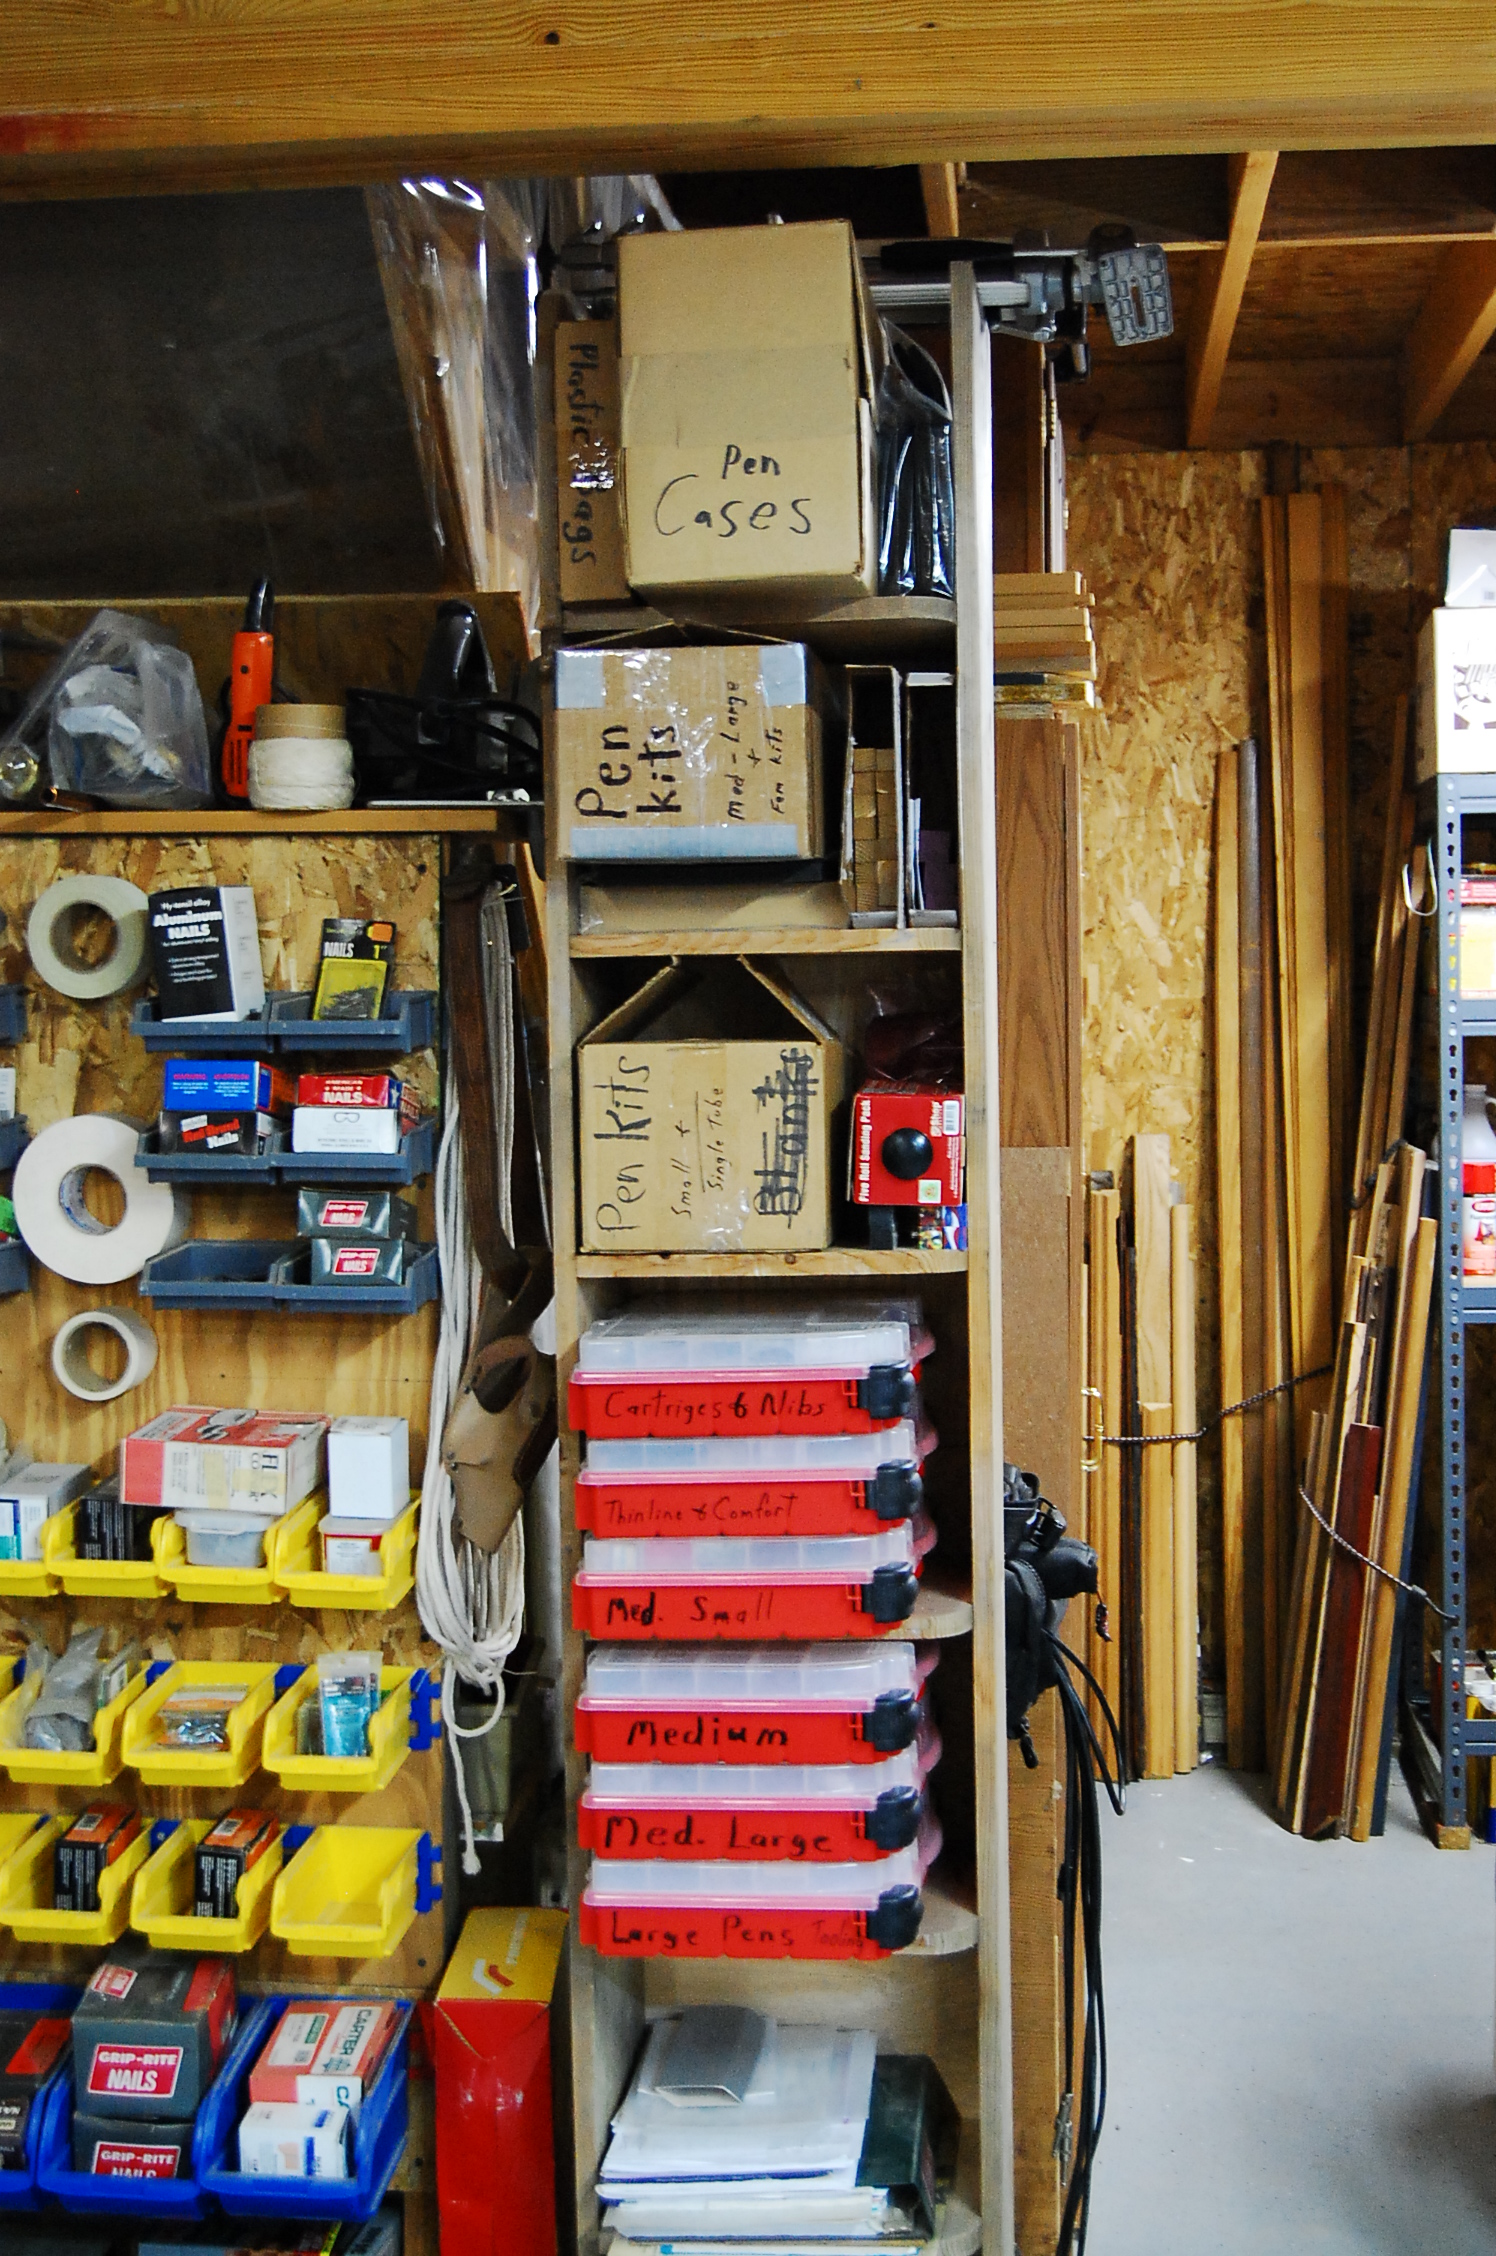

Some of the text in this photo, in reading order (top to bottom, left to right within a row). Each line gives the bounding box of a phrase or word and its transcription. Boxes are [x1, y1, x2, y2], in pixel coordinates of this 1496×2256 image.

[722, 444, 780, 479] Pen
[655, 474, 811, 537] Cases
[720, 681, 747, 743] Large
[575, 725, 633, 818] Pen
[153, 910, 222, 927] Aluminum
[167, 923, 210, 939] NAILS
[324, 942, 354, 957] NAILS
[323, 1091, 363, 1103] NAILS
[705, 1087, 732, 1191] Single Tube
[858, 1100, 872, 1202] Five Roll Sanding Pack
[596, 1163, 646, 1231] Pen
[670, 1158, 692, 1219] Small
[342, 1260, 367, 1272] NAILS
[760, 1390, 826, 1417] Nibs
[605, 1499, 682, 1525] Thinline
[713, 1492, 798, 1521] Comfort
[607, 1590, 774, 1626] Med. Small
[627, 1716, 788, 1746] Medium
[605, 1815, 832, 1856] Med. Large
[612, 1911, 699, 1949] Large
[723, 1914, 794, 1946] Pens
[339, 2008, 372, 2056] CARTER
[98, 2051, 177, 2066] GRIP-RITE
[107, 2069, 158, 2092] NAILS
[100, 2150, 174, 2165] GRIP-RITE
